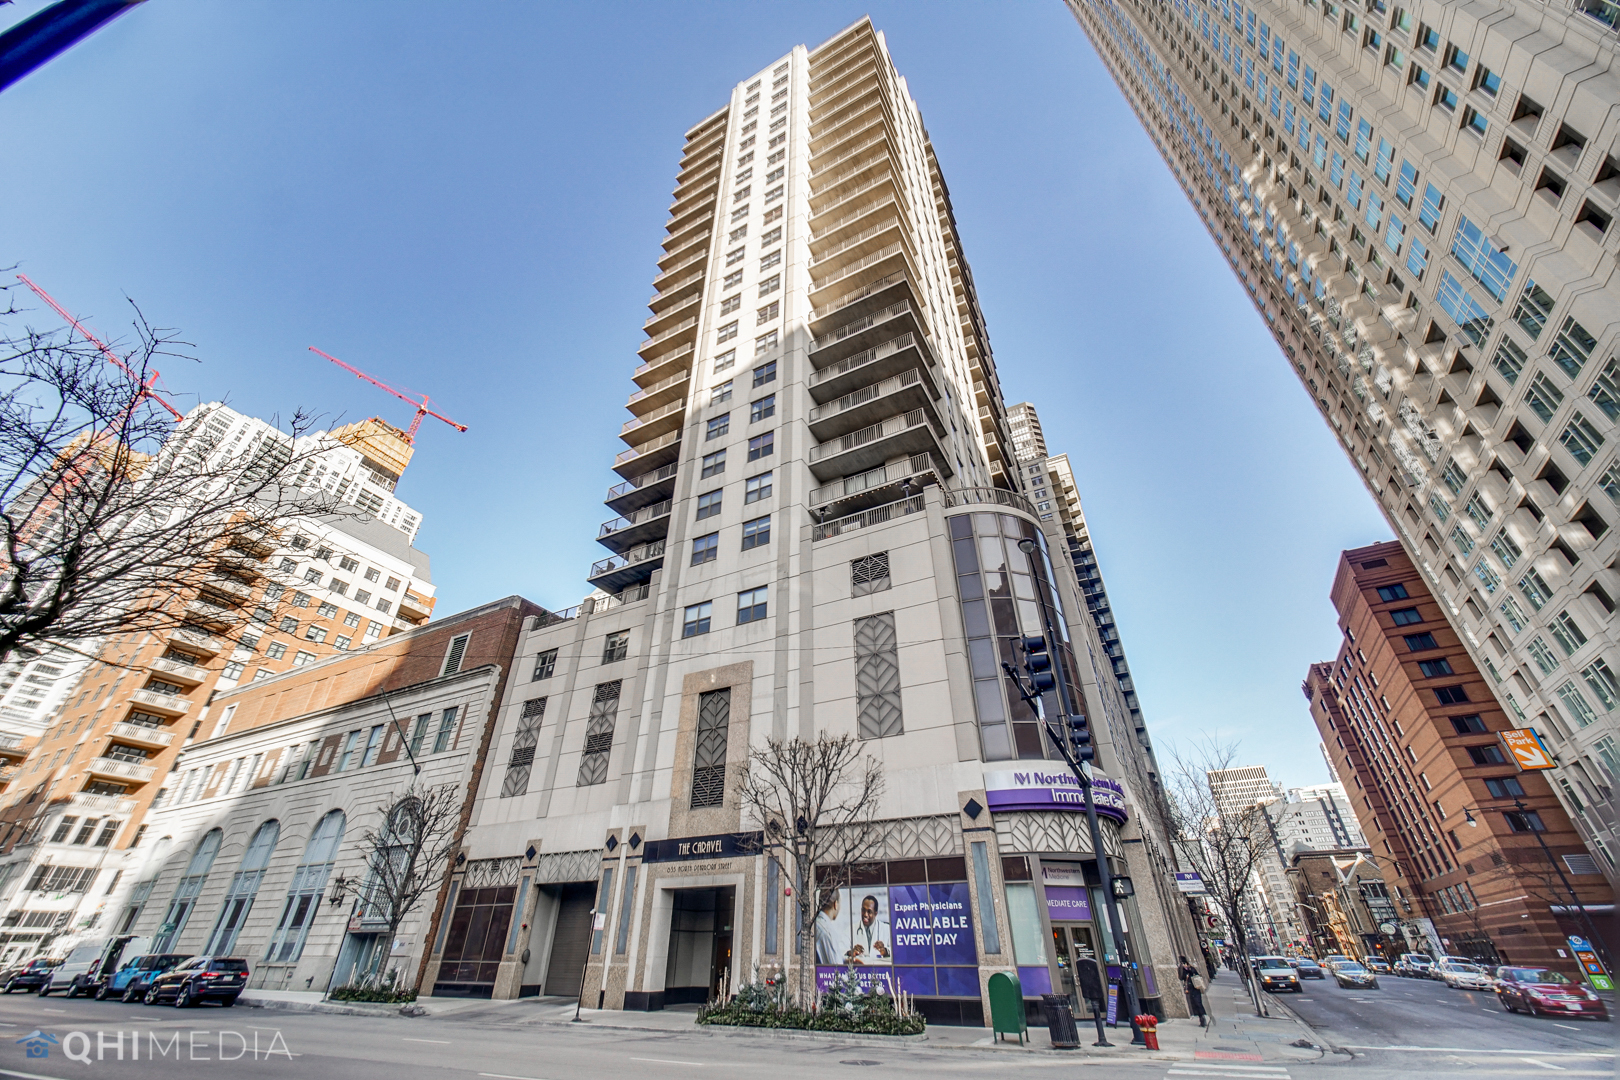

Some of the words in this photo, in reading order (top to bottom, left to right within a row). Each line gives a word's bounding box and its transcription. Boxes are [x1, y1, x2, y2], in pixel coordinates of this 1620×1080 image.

[1503, 730, 1525, 739] Self
[1507, 737, 1534, 746] Park
[1034, 772, 1110, 790] Northwtern
[1051, 788, 1110, 806] Immeiate
[678, 842, 691, 856] THE
[692, 839, 723, 854] CARAVEL
[894, 902, 918, 912] Expert
[919, 901, 963, 911] Physicians
[1046, 899, 1072, 908] MEDIATE
[1072, 900, 1088, 908] CARE
[895, 915, 969, 929] AVAILABLE
[896, 933, 932, 946] EVERY
[934, 933, 958, 945] DAY
[819, 972, 835, 980] WHAT
[859, 972, 867, 980] US
